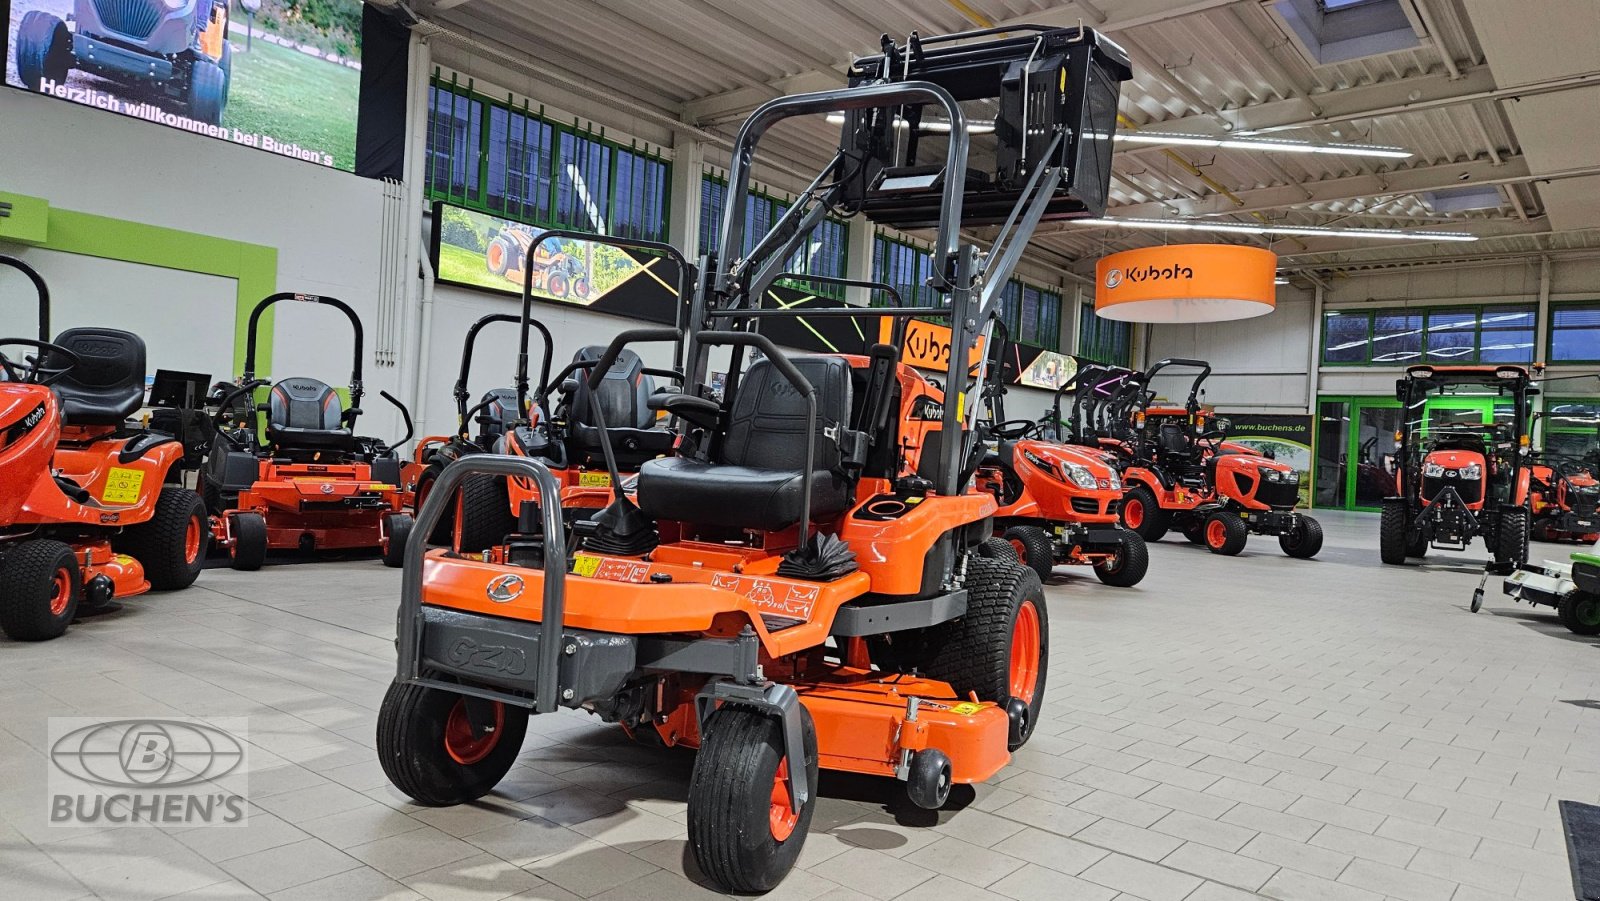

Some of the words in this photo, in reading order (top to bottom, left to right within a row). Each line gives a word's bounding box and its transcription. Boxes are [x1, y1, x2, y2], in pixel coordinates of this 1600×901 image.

[40, 76, 119, 111] Herzlich
[124, 100, 229, 140] willkommen
[233, 128, 258, 147] bei
[1126, 264, 1193, 282] Kubota
[906, 327, 951, 363] Kubo
[25, 407, 46, 427] Kubota
[924, 404, 945, 419] Kubot
[1234, 423, 1306, 432] www.buchens.de
[448, 636, 526, 676] GZD
